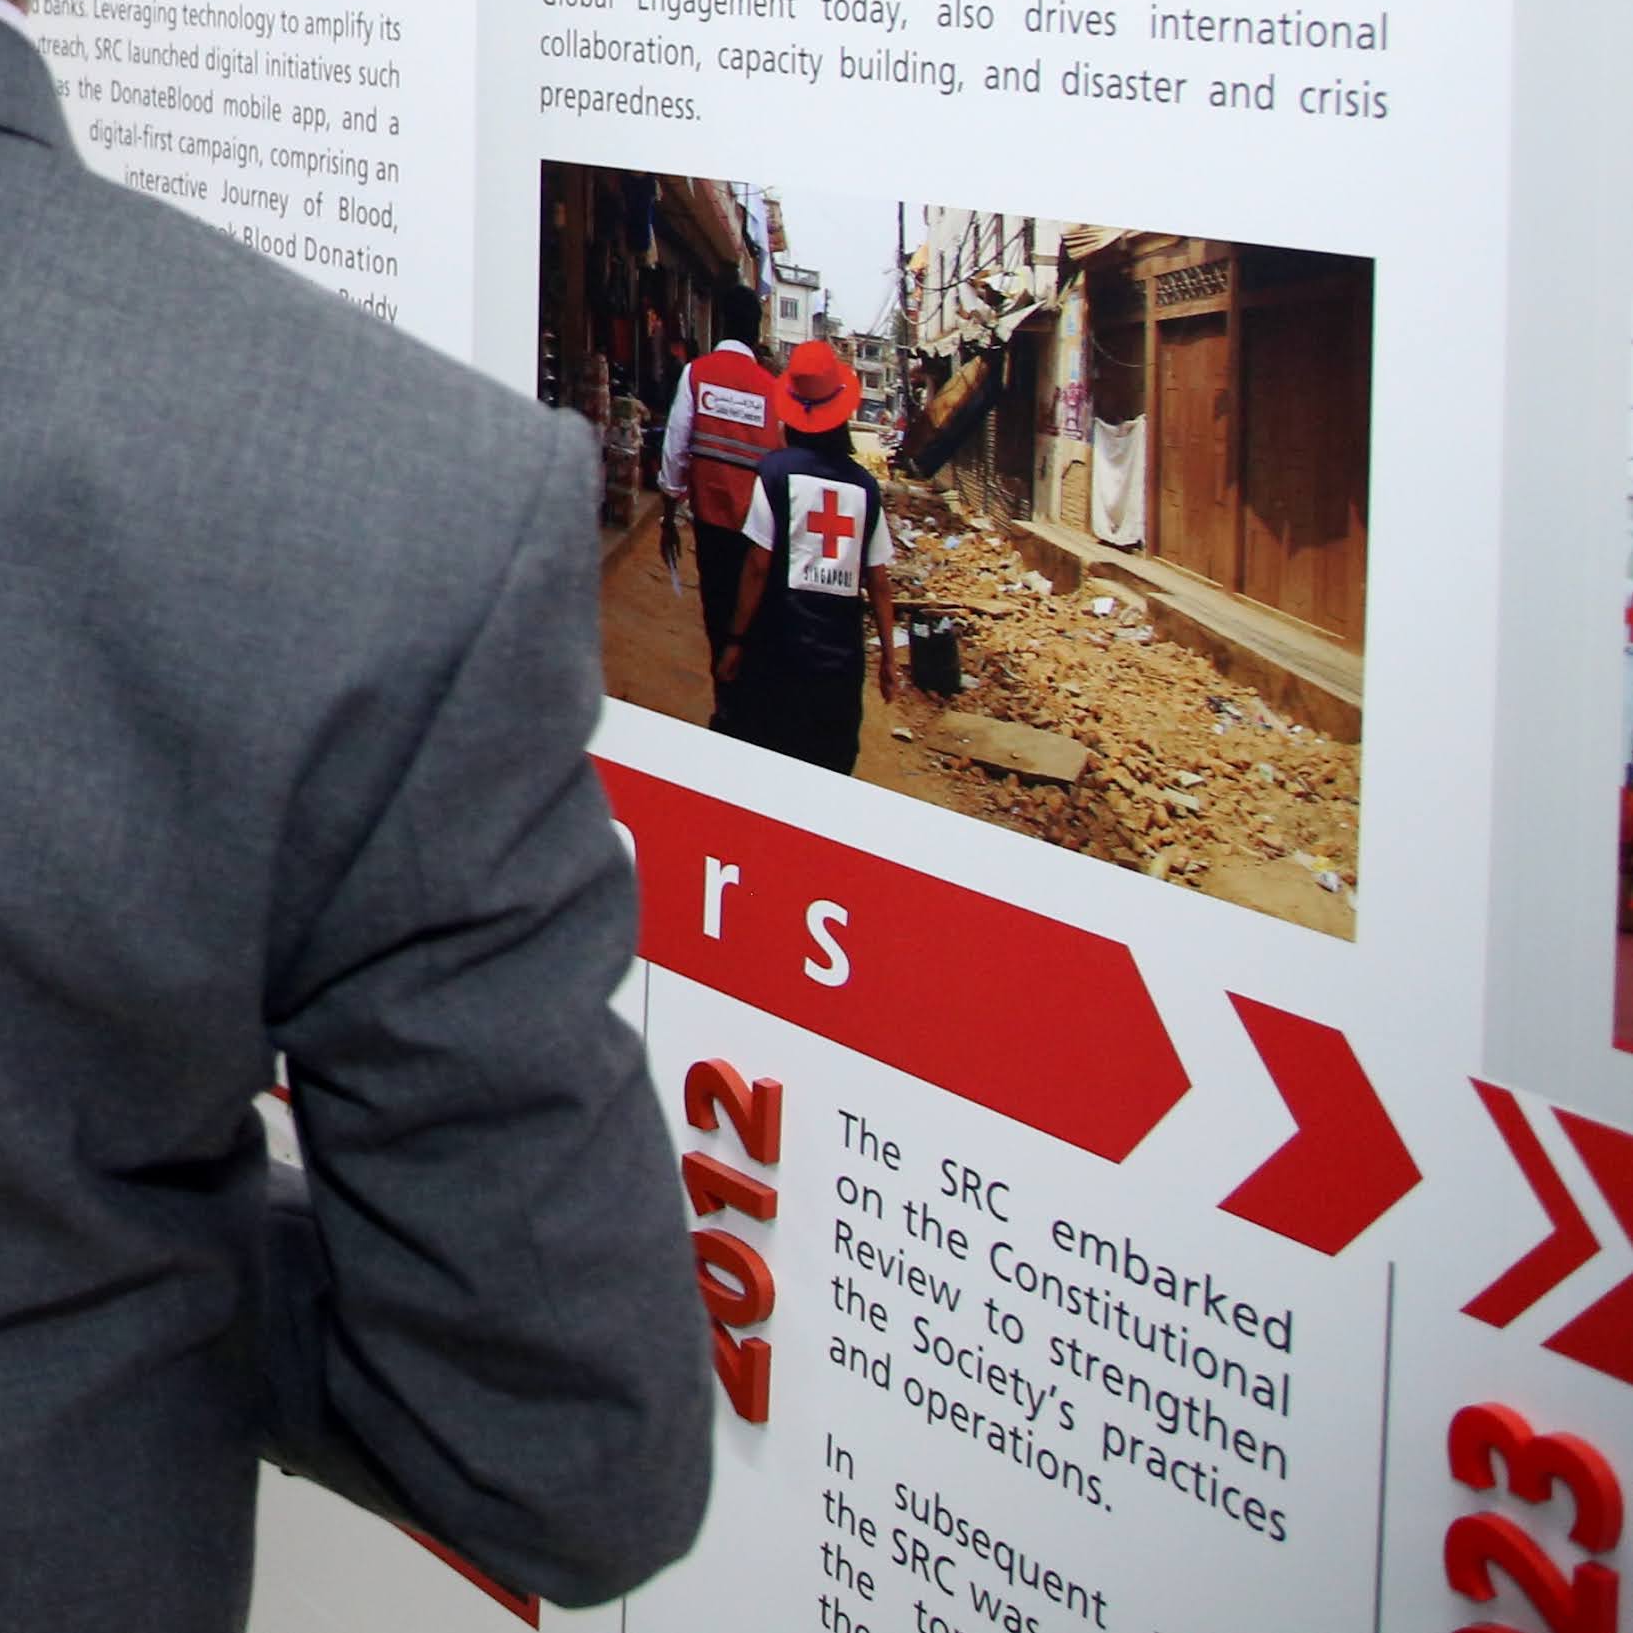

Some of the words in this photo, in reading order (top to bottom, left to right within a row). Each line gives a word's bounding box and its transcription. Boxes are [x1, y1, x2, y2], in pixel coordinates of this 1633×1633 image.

[94, 36, 123, 64] SRC
[127, 39, 200, 70] launched
[204, 45, 259, 81] digital
[265, 50, 353, 85] initiatives
[358, 58, 400, 89] such
[1150, 2, 1389, 51] international
[89, 118, 174, 153] digital-first
[177, 135, 264, 169] campaign,
[269, 146, 370, 187] comprising
[374, 160, 400, 184] an
[539, 84, 702, 121] preparedness.
[124, 164, 208, 201] interactive
[220, 178, 290, 220] Journey
[302, 189, 324, 218] of
[337, 195, 399, 235] Blood,
[242, 225, 298, 260] Blood
[303, 235, 399, 278] Donation
[681, 1057, 784, 1425] 2012
[836, 1108, 902, 1172] The
[940, 1157, 1011, 1224] SRC
[1051, 1219, 1293, 1355] embarked
[834, 1217, 962, 1313] Review
[982, 1297, 1025, 1345] to
[1048, 1335, 1288, 1481] strengthen
[835, 1175, 884, 1221] on
[900, 1199, 970, 1262] the
[988, 1240, 1291, 1418] Constitutional
[828, 1335, 892, 1392] and
[903, 1376, 1113, 1513] operations.
[830, 1275, 889, 1334] the
[1102, 1421, 1287, 1543] practices
[819, 1540, 876, 1603] the
[821, 1488, 878, 1549] the
[890, 1527, 957, 1598] SRC
[825, 1431, 854, 1481] In
[894, 1482, 1108, 1631] subsequent
